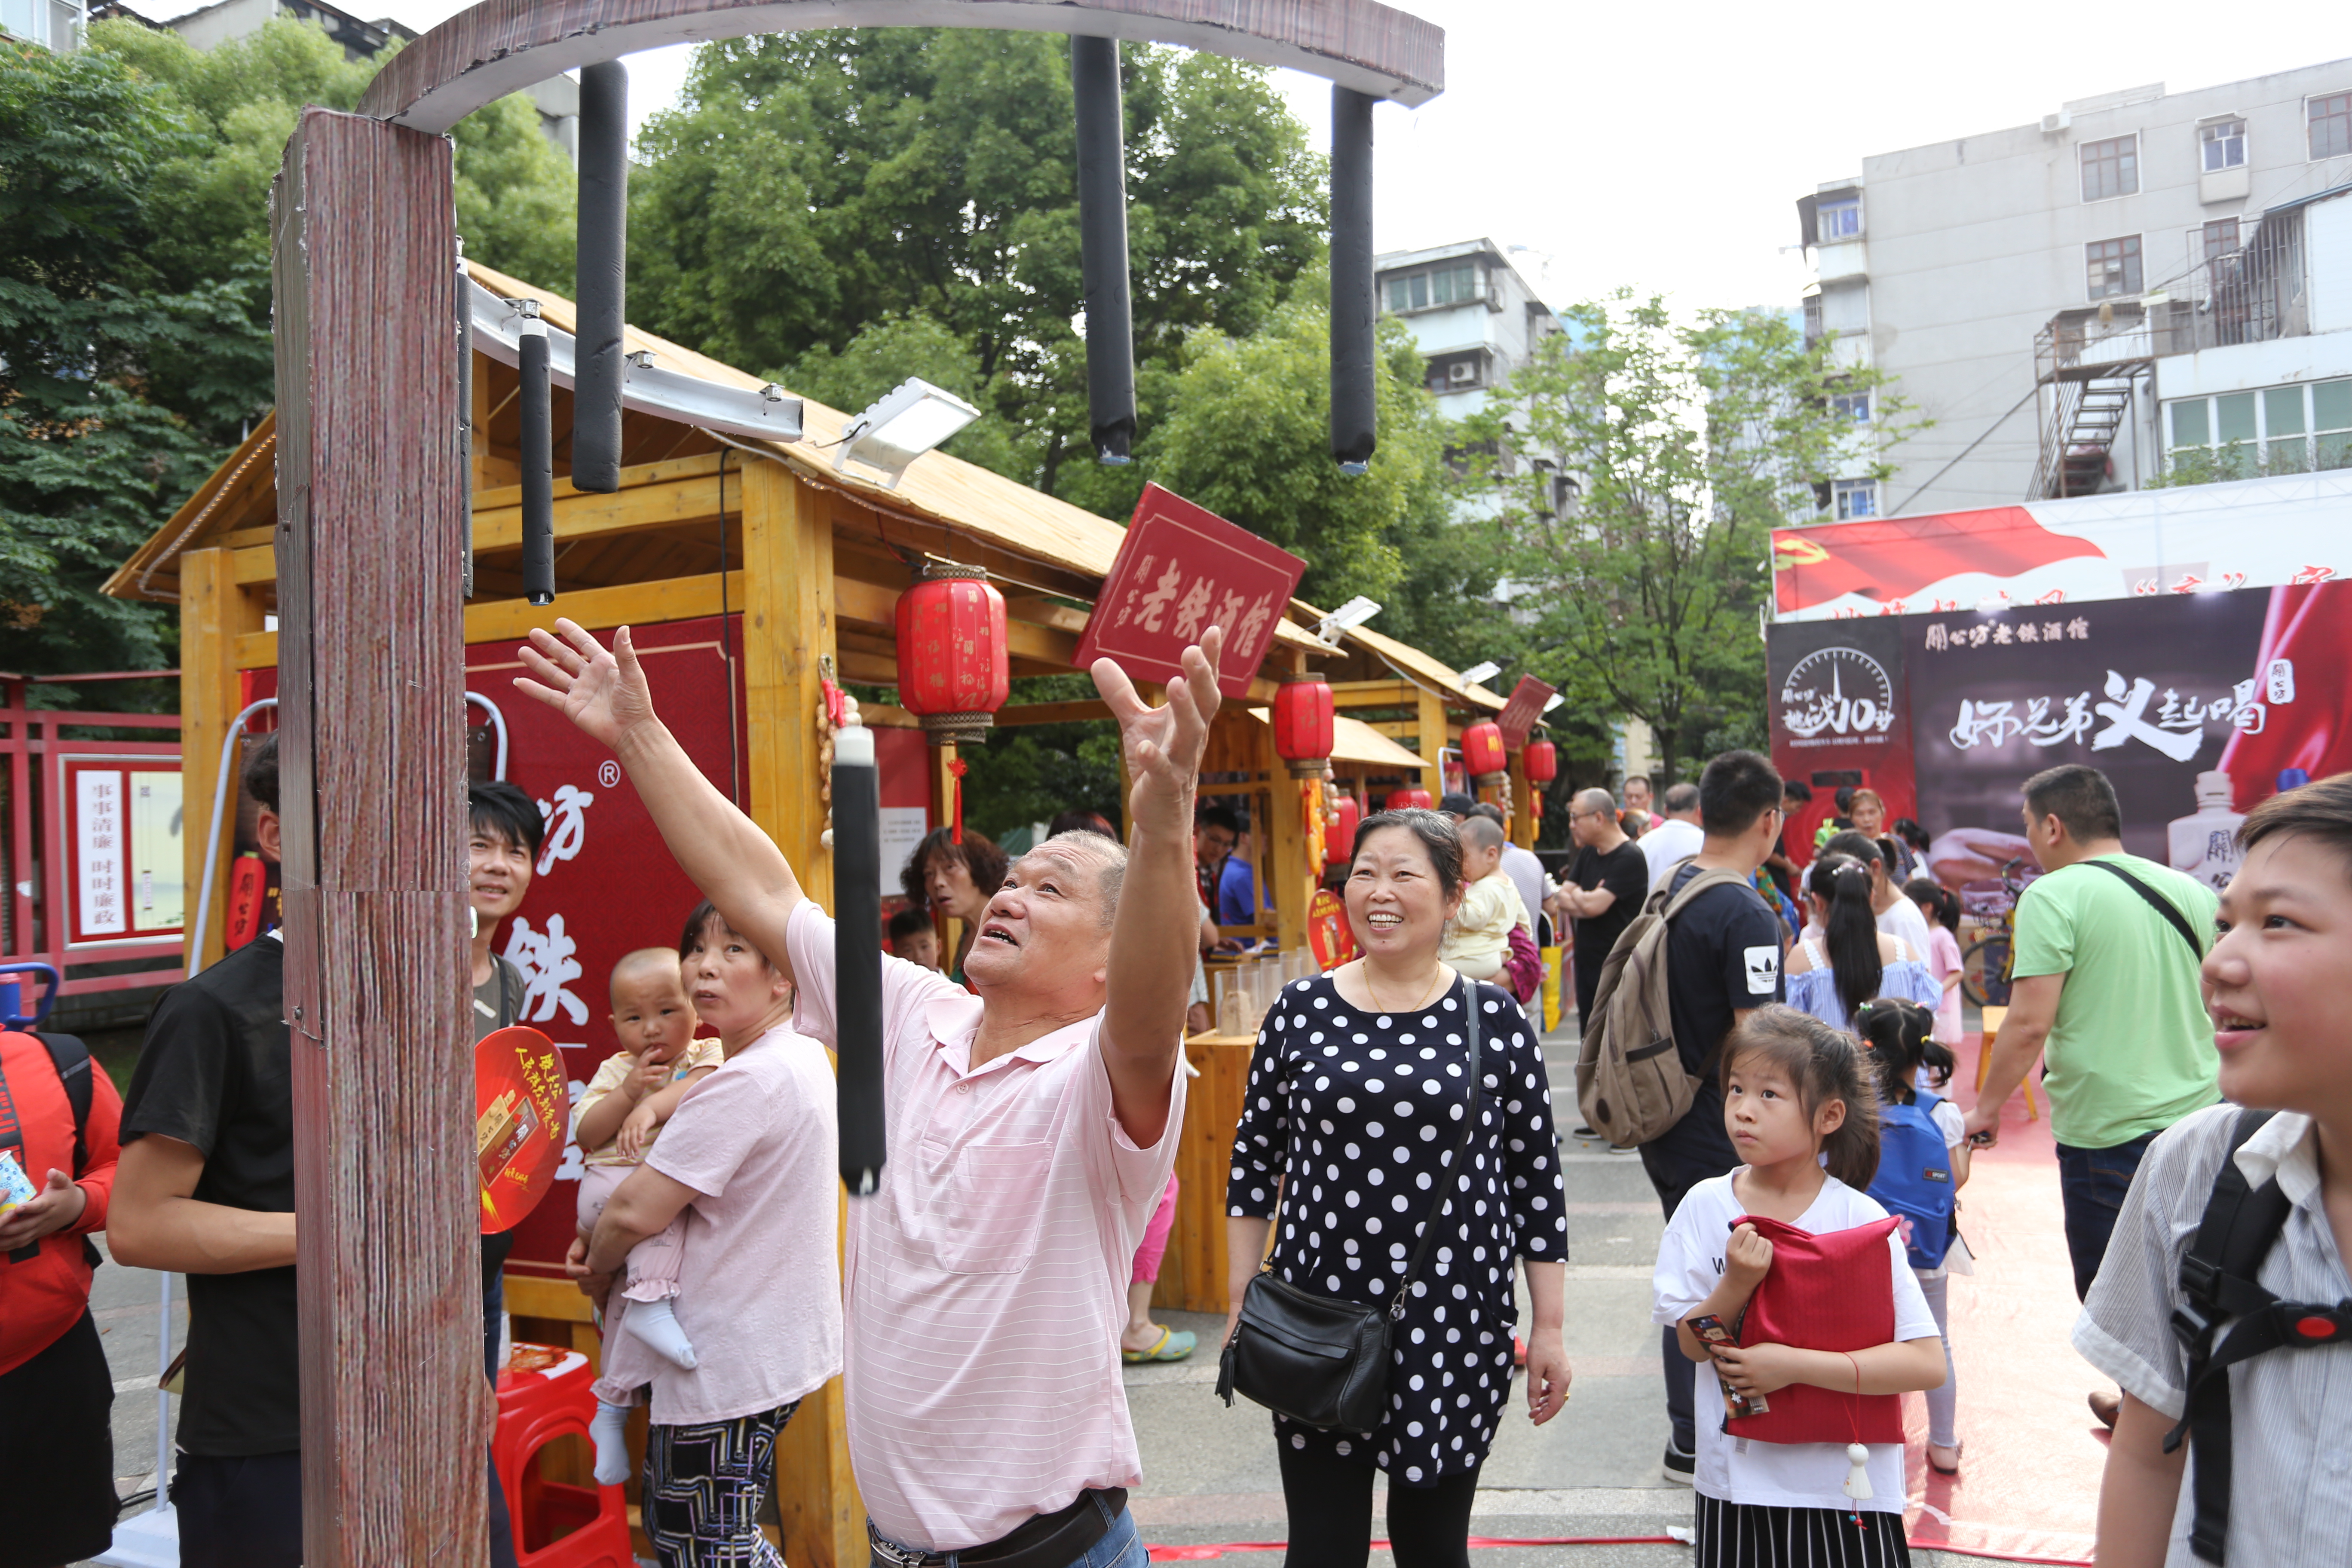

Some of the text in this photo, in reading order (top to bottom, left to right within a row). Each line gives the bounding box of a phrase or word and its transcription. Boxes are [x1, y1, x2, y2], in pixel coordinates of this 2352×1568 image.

[92, 784, 116, 925] 事事清廉 时时廉政
